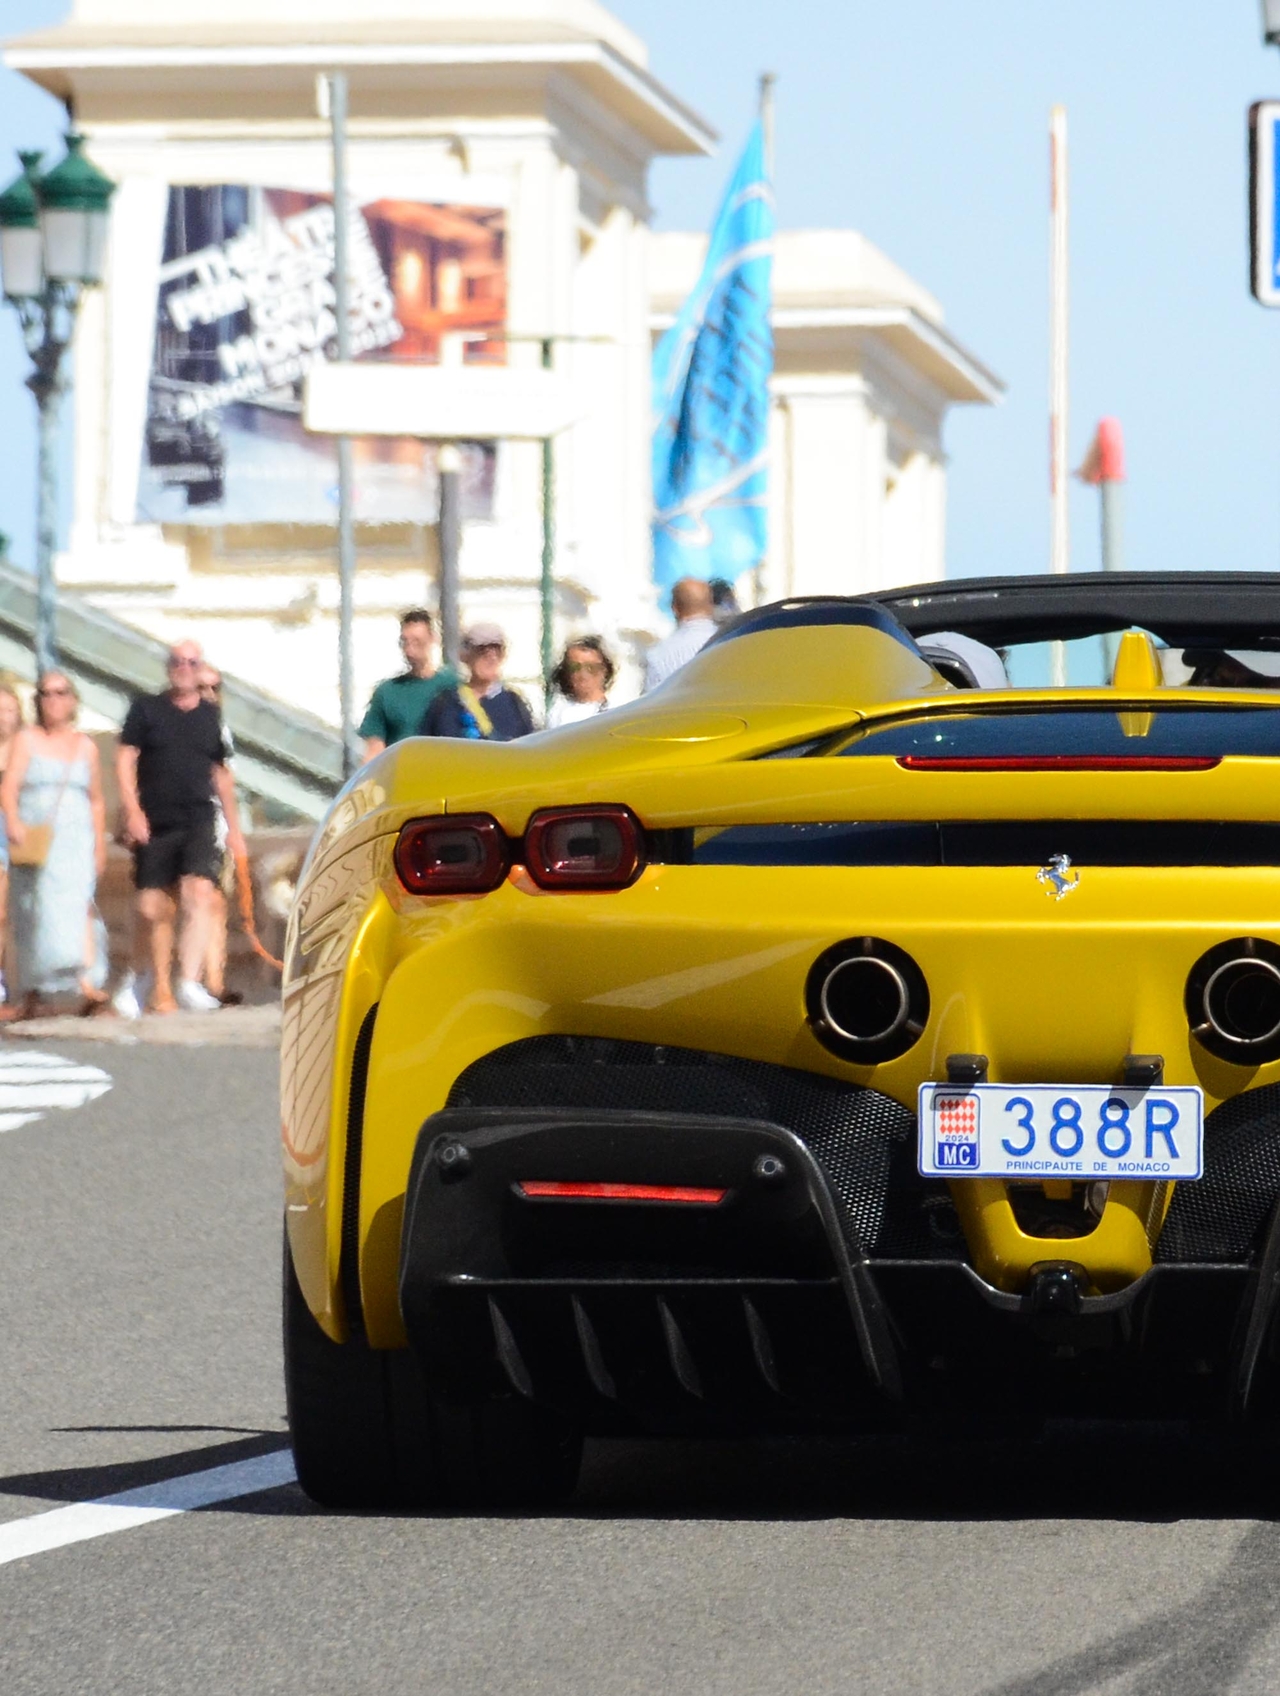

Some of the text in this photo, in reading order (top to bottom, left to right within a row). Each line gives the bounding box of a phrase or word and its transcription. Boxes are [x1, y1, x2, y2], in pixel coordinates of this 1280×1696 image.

[218, 290, 393, 377] MONACO
[945, 1134, 969, 1142] 2024
[1001, 1096, 1180, 1159] 388R
[943, 1145, 971, 1166] MC
[1006, 1160, 1170, 1172] PRINCIPAUTE DE MONACO
